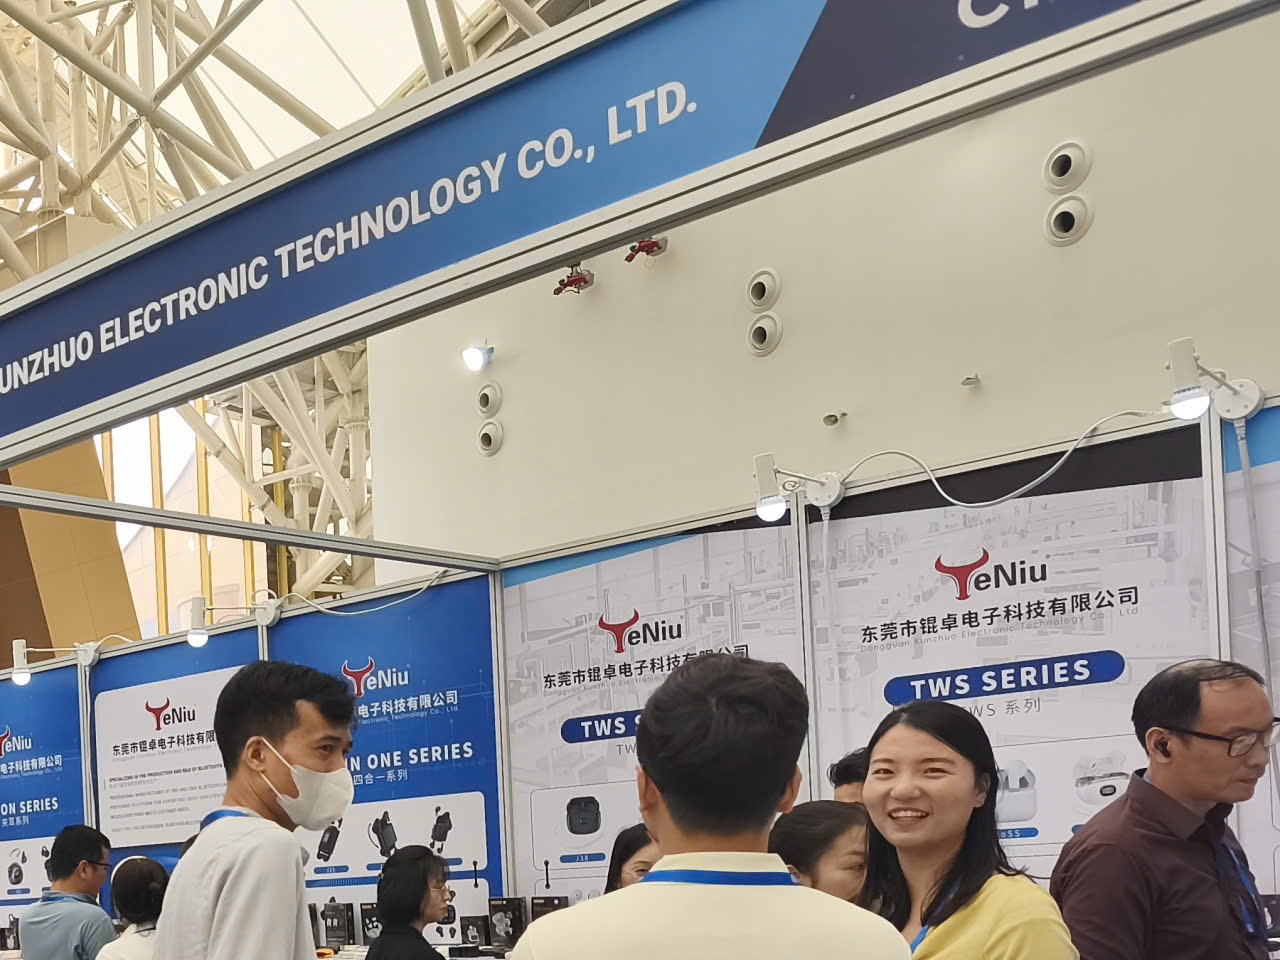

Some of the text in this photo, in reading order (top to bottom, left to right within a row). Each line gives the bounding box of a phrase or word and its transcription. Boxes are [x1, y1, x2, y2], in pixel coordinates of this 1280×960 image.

[99, 255, 269, 353] ELECTRONIC
[273, 152, 508, 279] TECHNOLOGY
[517, 127, 596, 180] CO.,
[606, 80, 698, 145] LTD.
[860, 585, 1140, 644] 东莞市锟卓电子科技有限公司
[860, 641, 911, 654] Dongguan
[543, 644, 750, 689] 东莞市锟卓电子科技司
[910, 658, 1091, 700] TWS SERIES
[964, 694, 1042, 718] WS 系列
[580, 717, 626, 738] TWS
[367, 750, 402, 770] ONE
[408, 741, 474, 765] SERIES
[353, 768, 408, 785] 四合一系列
[19, 797, 59, 813] SERIES
